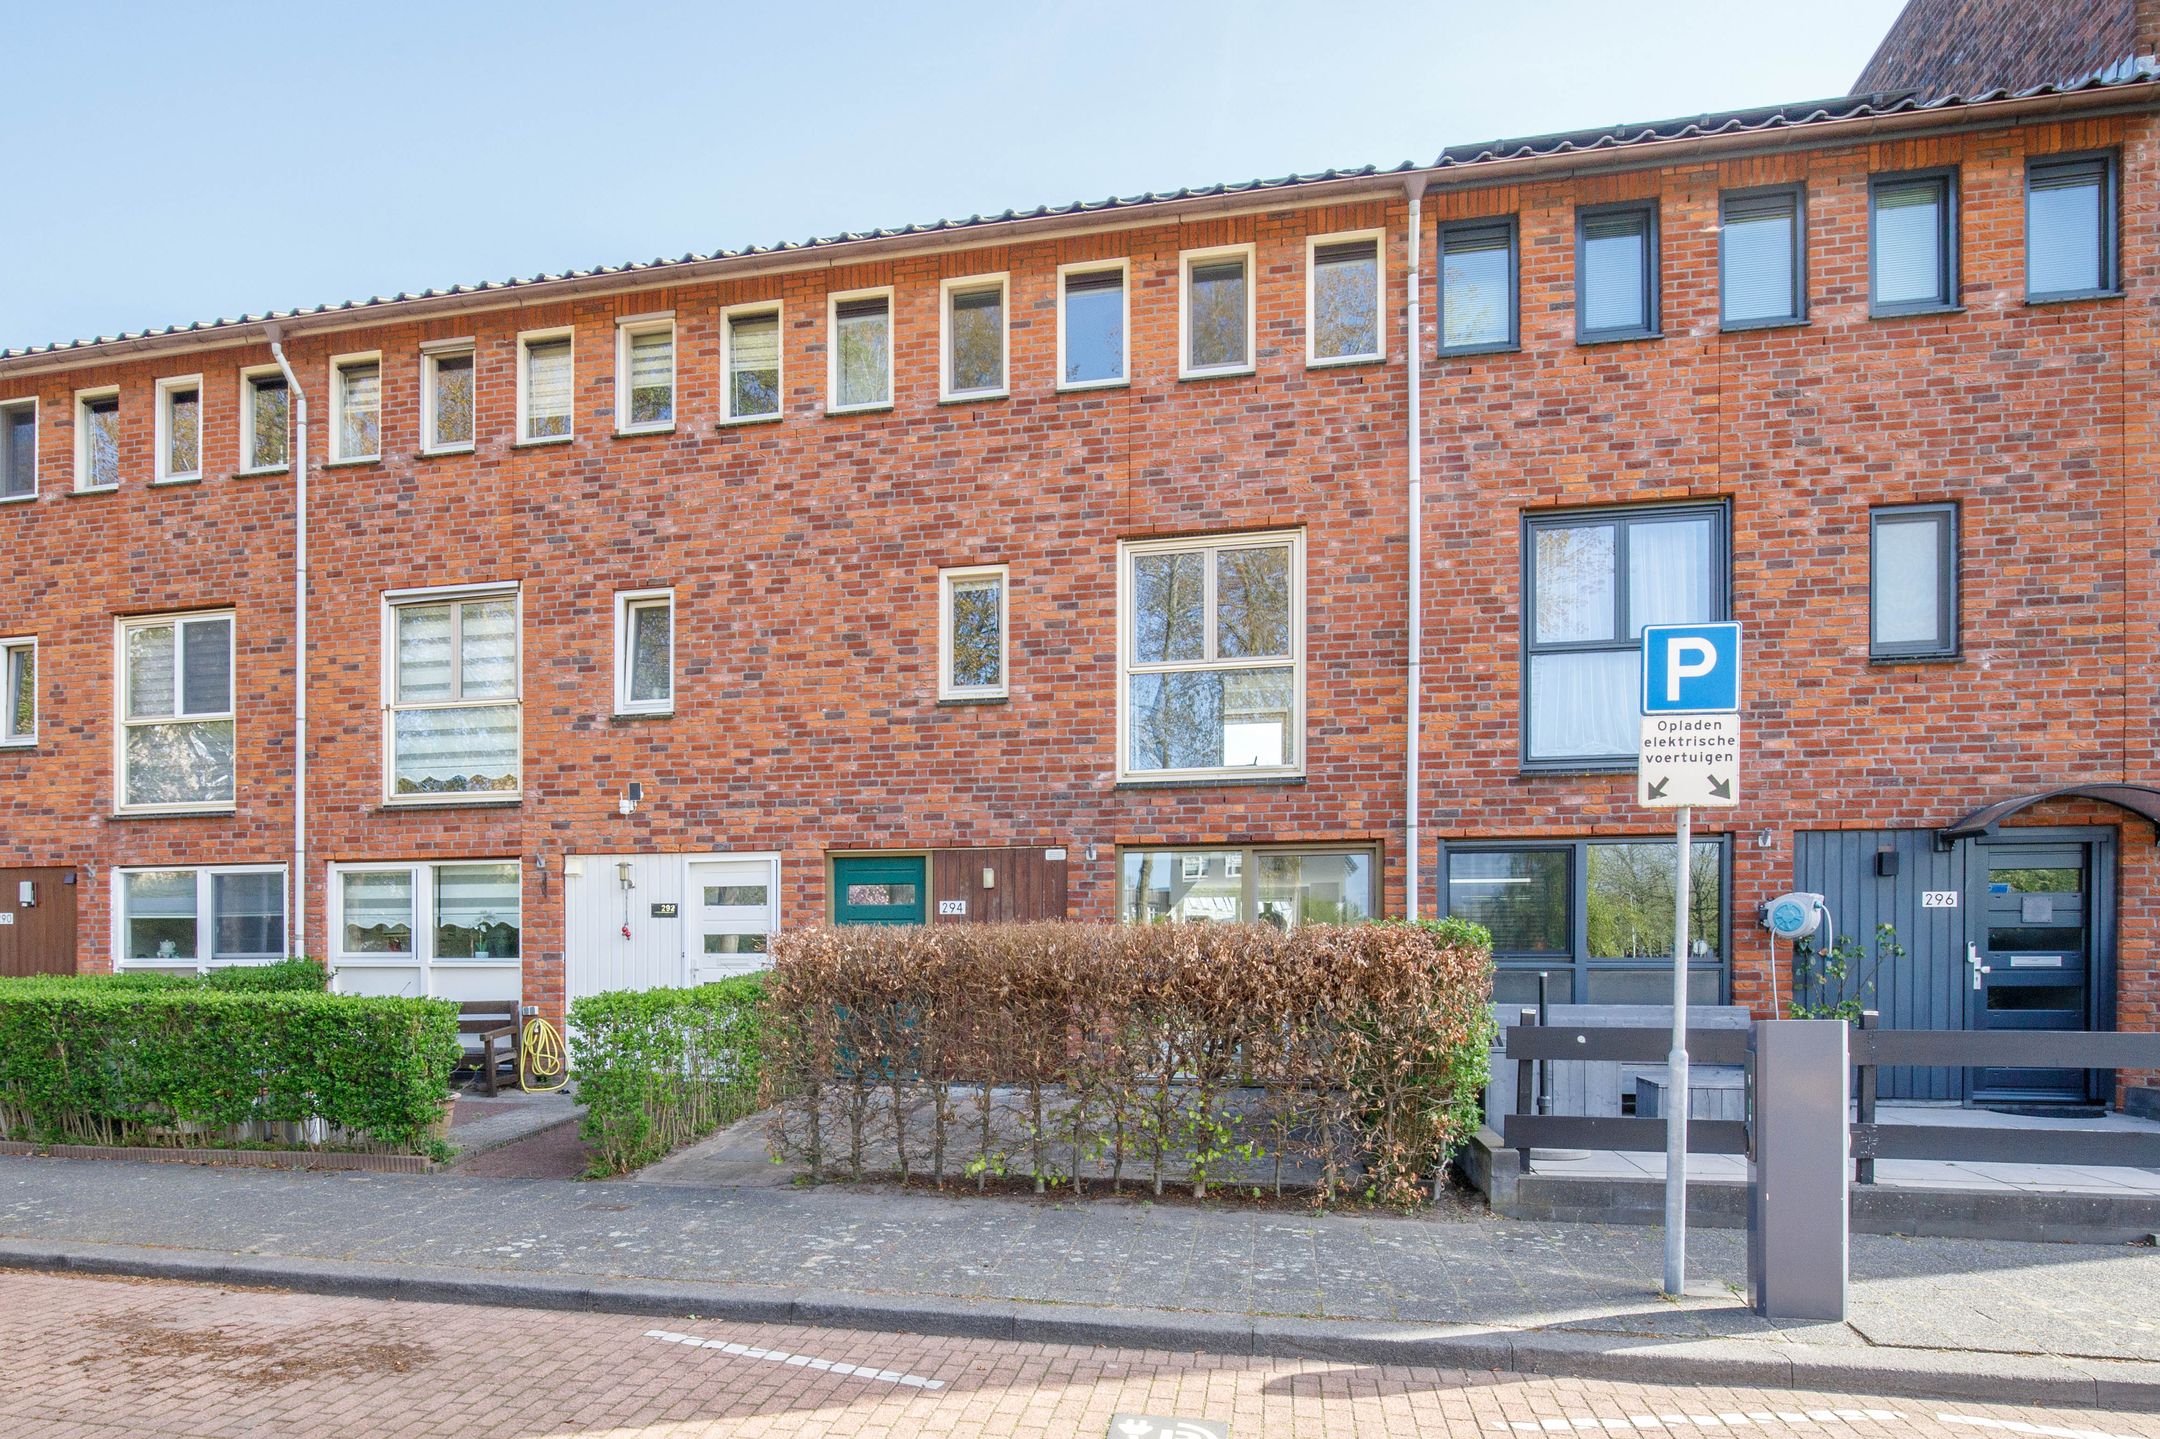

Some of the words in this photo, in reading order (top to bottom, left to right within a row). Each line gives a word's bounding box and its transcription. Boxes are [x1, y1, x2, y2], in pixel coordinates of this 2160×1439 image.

[1667, 637, 1717, 701] P
[1657, 720, 1722, 732] Opladen
[1644, 735, 1735, 747] elektrische
[1646, 751, 1733, 765] voertuigen
[1925, 893, 1954, 906] 296
[661, 904, 676, 912] 292
[942, 902, 962, 912] 294
[0, 914, 11, 923] 90
